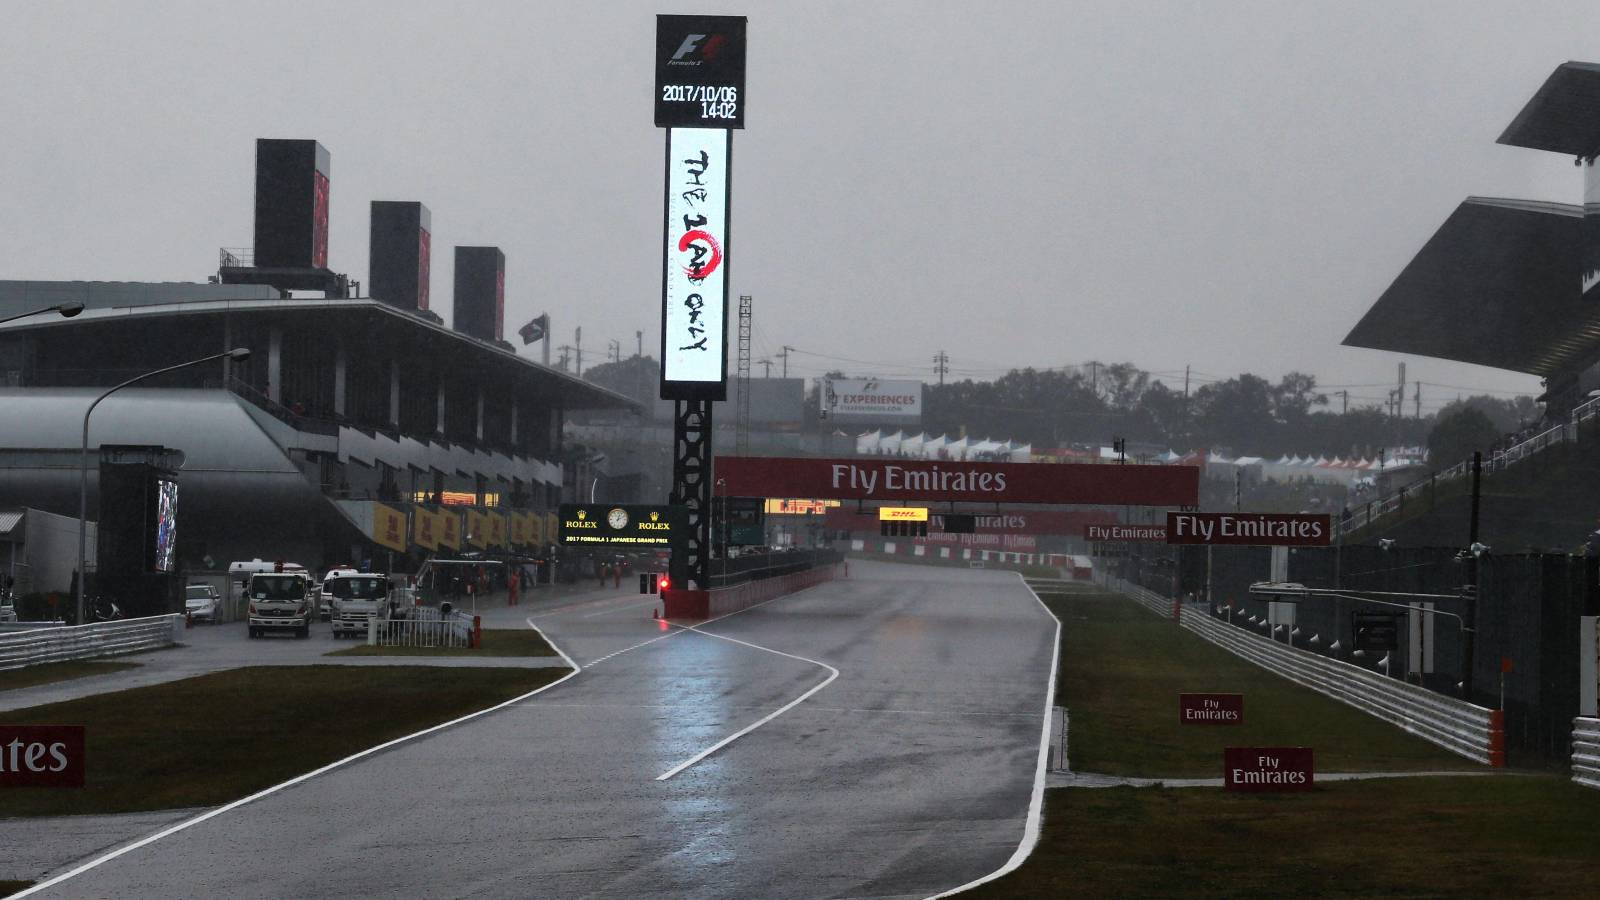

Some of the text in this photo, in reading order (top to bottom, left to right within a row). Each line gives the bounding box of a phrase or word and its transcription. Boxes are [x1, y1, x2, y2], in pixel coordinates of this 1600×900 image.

[663, 85, 737, 102] 2017/10/06
[701, 102, 737, 118] 14:02
[682, 150, 709, 207] THE
[679, 293, 708, 351] ONLY
[843, 394, 915, 404] EXPERIENCES
[832, 464, 1007, 494] Fly Emirates
[1089, 526, 1166, 540] Fly Emirates
[1175, 516, 1322, 540] Fly Emirates
[1204, 699, 1219, 709] Fly
[1186, 708, 1238, 720] Emirates
[0, 736, 67, 772] tes
[1258, 756, 1279, 768] Fly
[1232, 768, 1306, 783] Emirates
